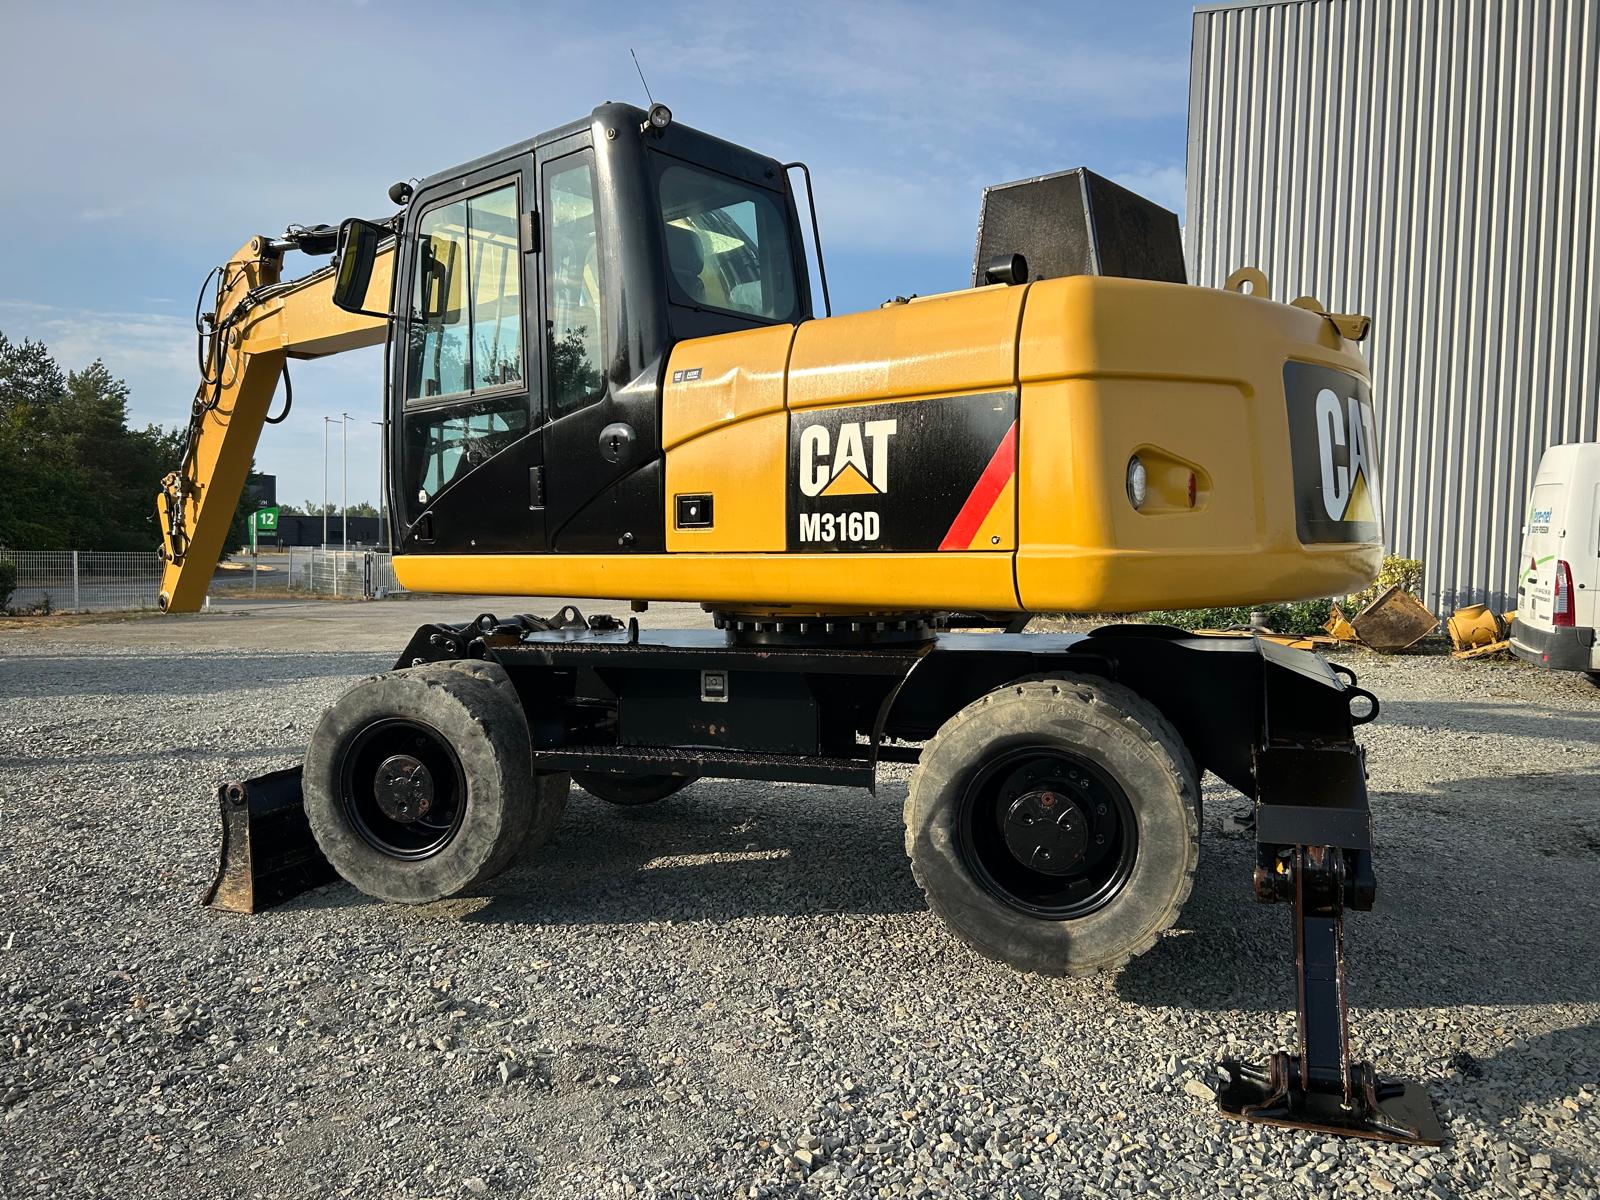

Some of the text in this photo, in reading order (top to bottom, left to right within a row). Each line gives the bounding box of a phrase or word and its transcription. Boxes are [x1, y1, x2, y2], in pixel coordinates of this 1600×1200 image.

[799, 419, 897, 497] CAT
[1315, 388, 1378, 522] CAT
[261, 513, 274, 524] 12
[799, 511, 880, 542] M316D
